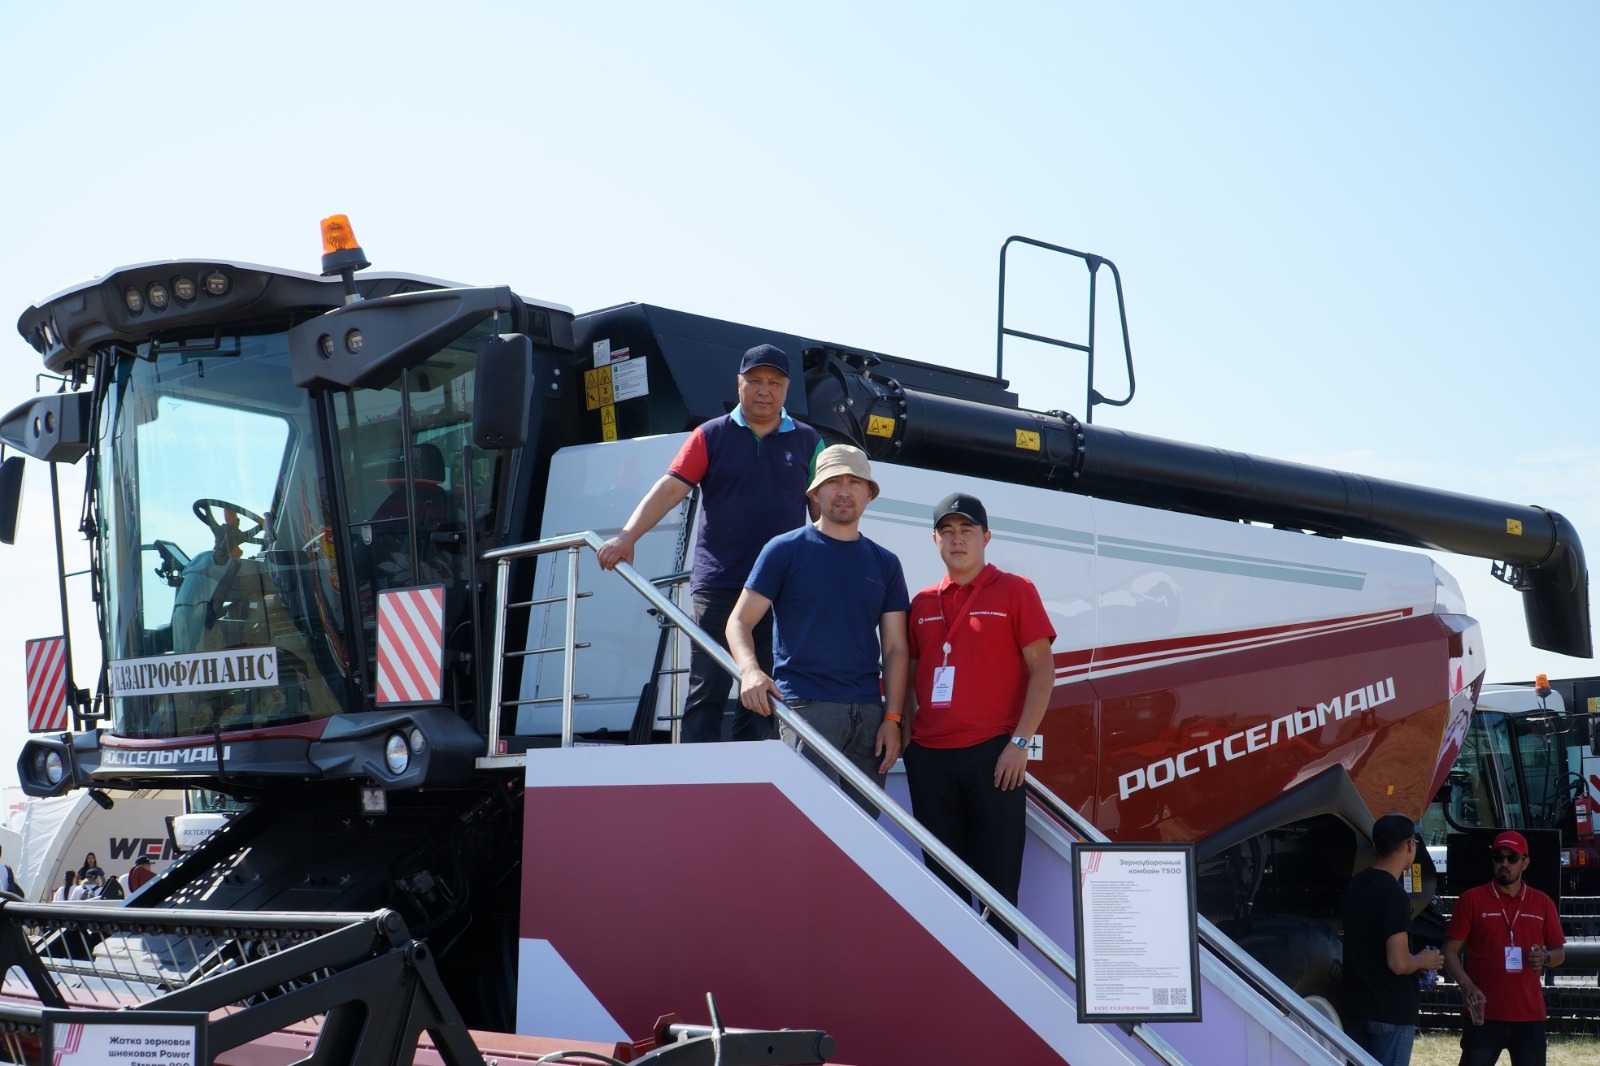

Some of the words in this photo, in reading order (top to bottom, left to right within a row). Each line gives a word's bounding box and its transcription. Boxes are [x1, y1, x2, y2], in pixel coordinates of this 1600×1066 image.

[113, 653, 275, 691] КАЗАГРОФИНАНС
[1117, 676, 1397, 801] РОСТСЕЛЬМАШ
[1119, 859, 1182, 867] Зерноуборочный
[1128, 867, 1160, 875] комбайн
[109, 1036, 142, 1045] Жатка
[144, 1038, 191, 1047] зерновая
[108, 1049, 157, 1058] шнековая
[159, 1050, 191, 1059] Power
